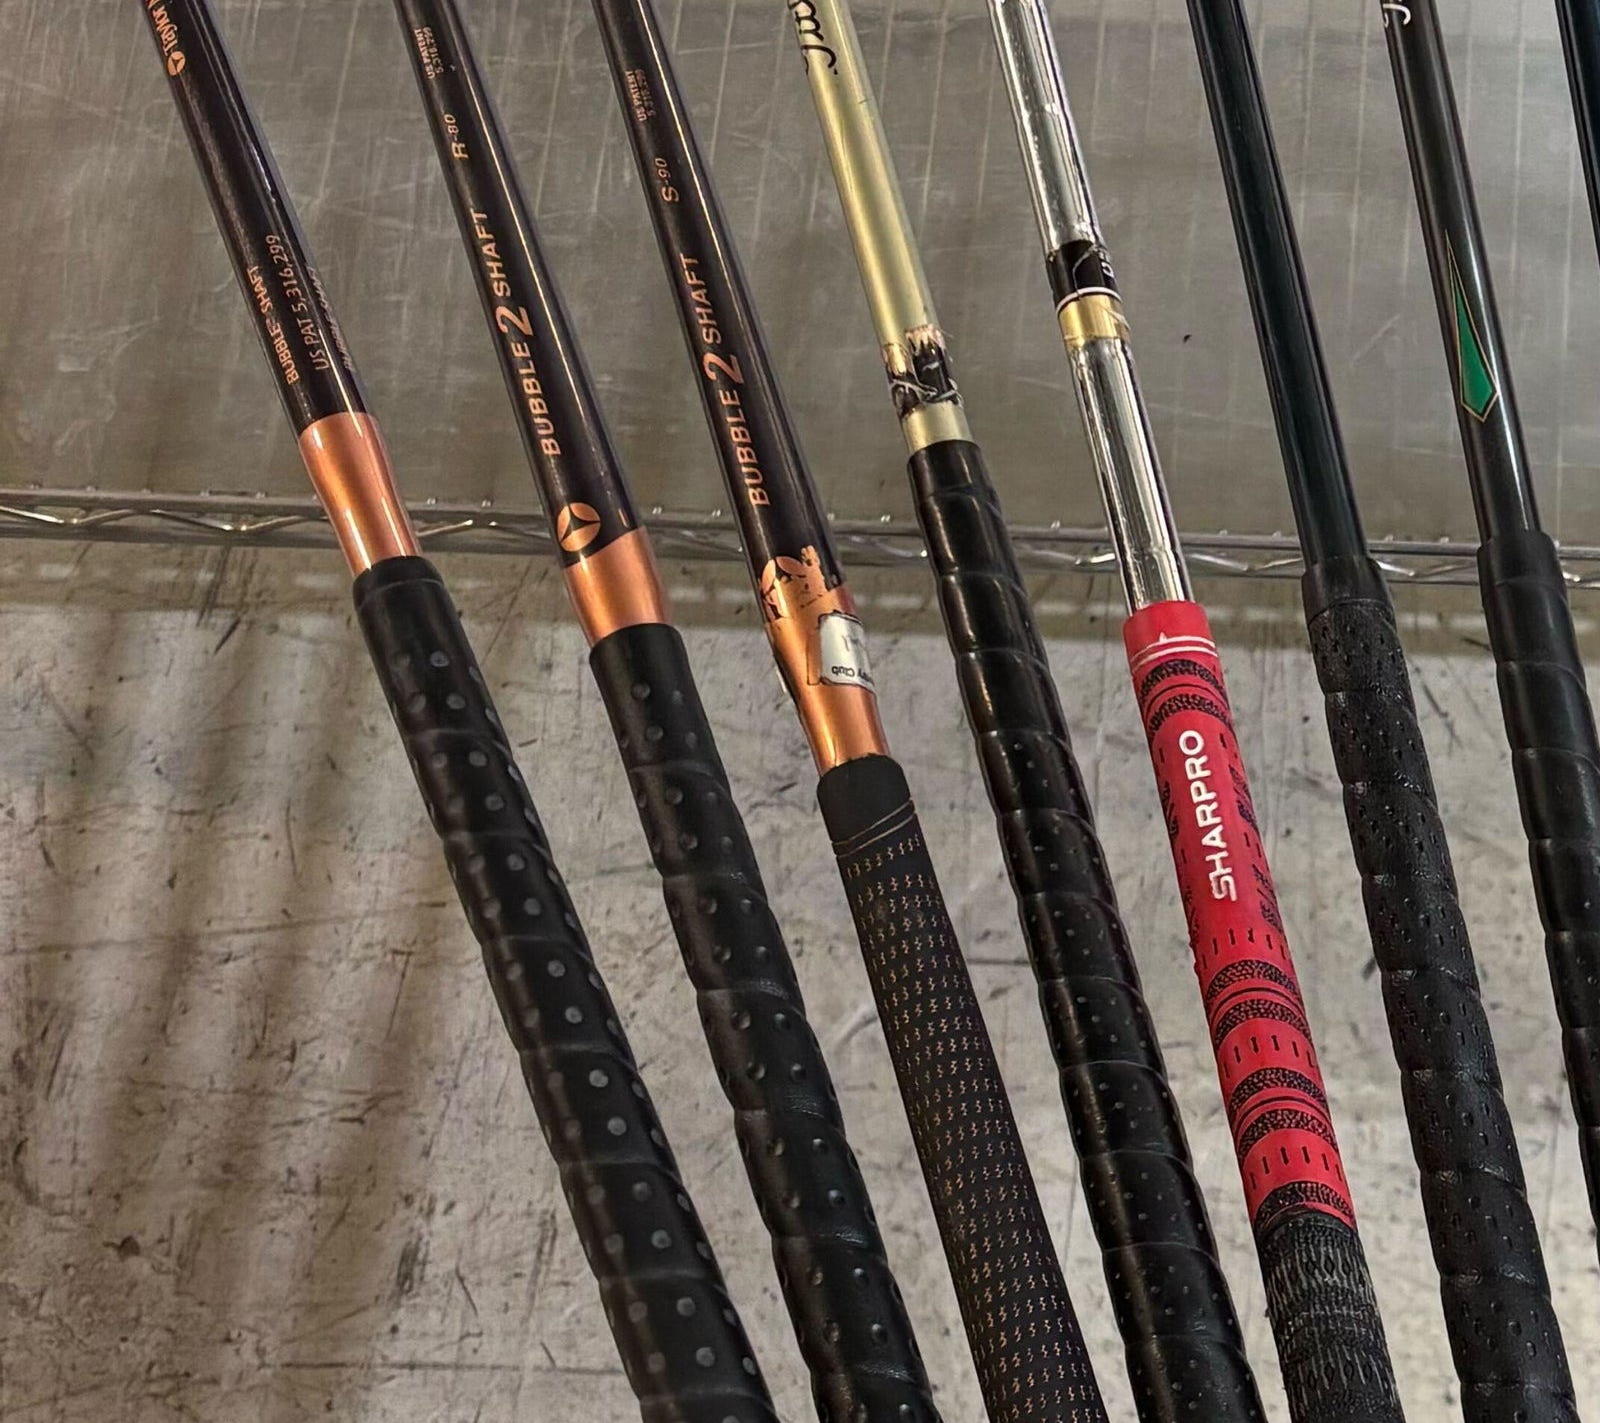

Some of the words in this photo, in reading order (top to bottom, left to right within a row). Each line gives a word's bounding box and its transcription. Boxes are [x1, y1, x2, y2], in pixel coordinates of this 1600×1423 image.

[152, 7, 179, 56] Taylor
[654, 158, 680, 203] S-90
[266, 234, 308, 313] 5,316,299
[470, 207, 511, 298] SHAFT
[247, 265, 273, 313] SHAFT
[680, 252, 721, 345] SHAFT
[297, 318, 320, 345] PAT
[495, 305, 534, 337] 2
[267, 322, 299, 385] BUBBLE
[310, 349, 330, 370] US
[703, 352, 745, 385] 2
[511, 342, 561, 456] BUBBLE
[719, 389, 770, 507] BUBBLE
[831, 665, 856, 678] Club
[1178, 729, 1238, 902] SHARPRO
